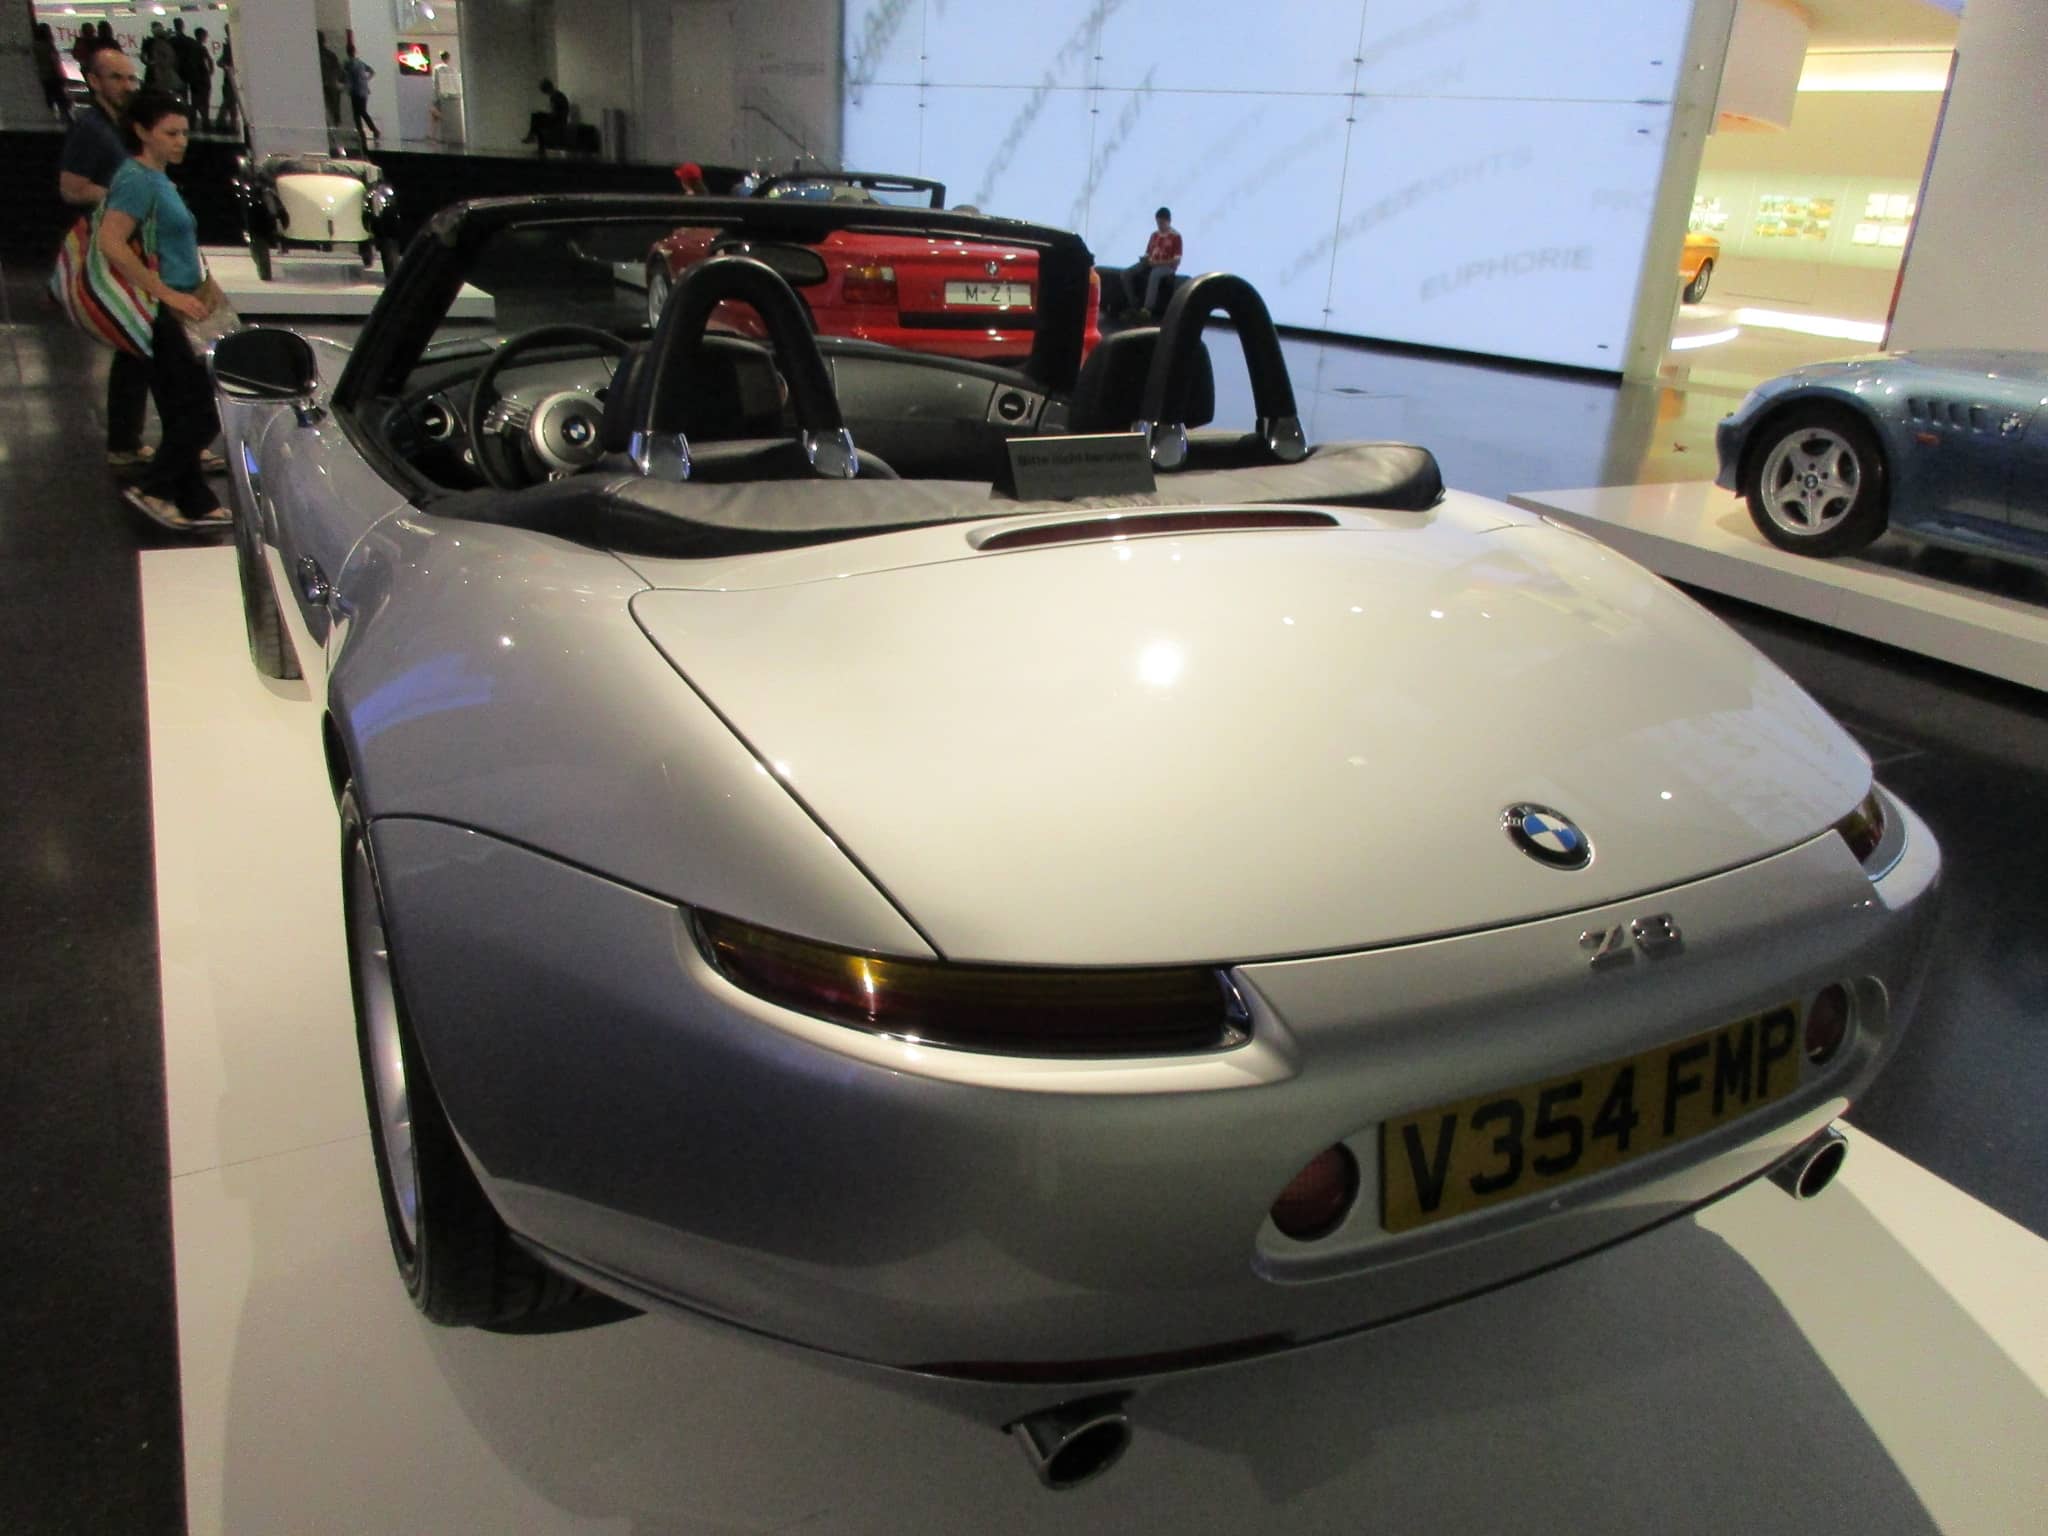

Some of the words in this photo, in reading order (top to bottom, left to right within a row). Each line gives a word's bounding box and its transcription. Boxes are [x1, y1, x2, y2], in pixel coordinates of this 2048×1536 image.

[1420, 246, 1592, 302] EUPHORIE
[1402, 1064, 1639, 1214] V354
[1661, 1006, 1796, 1137] FMP
